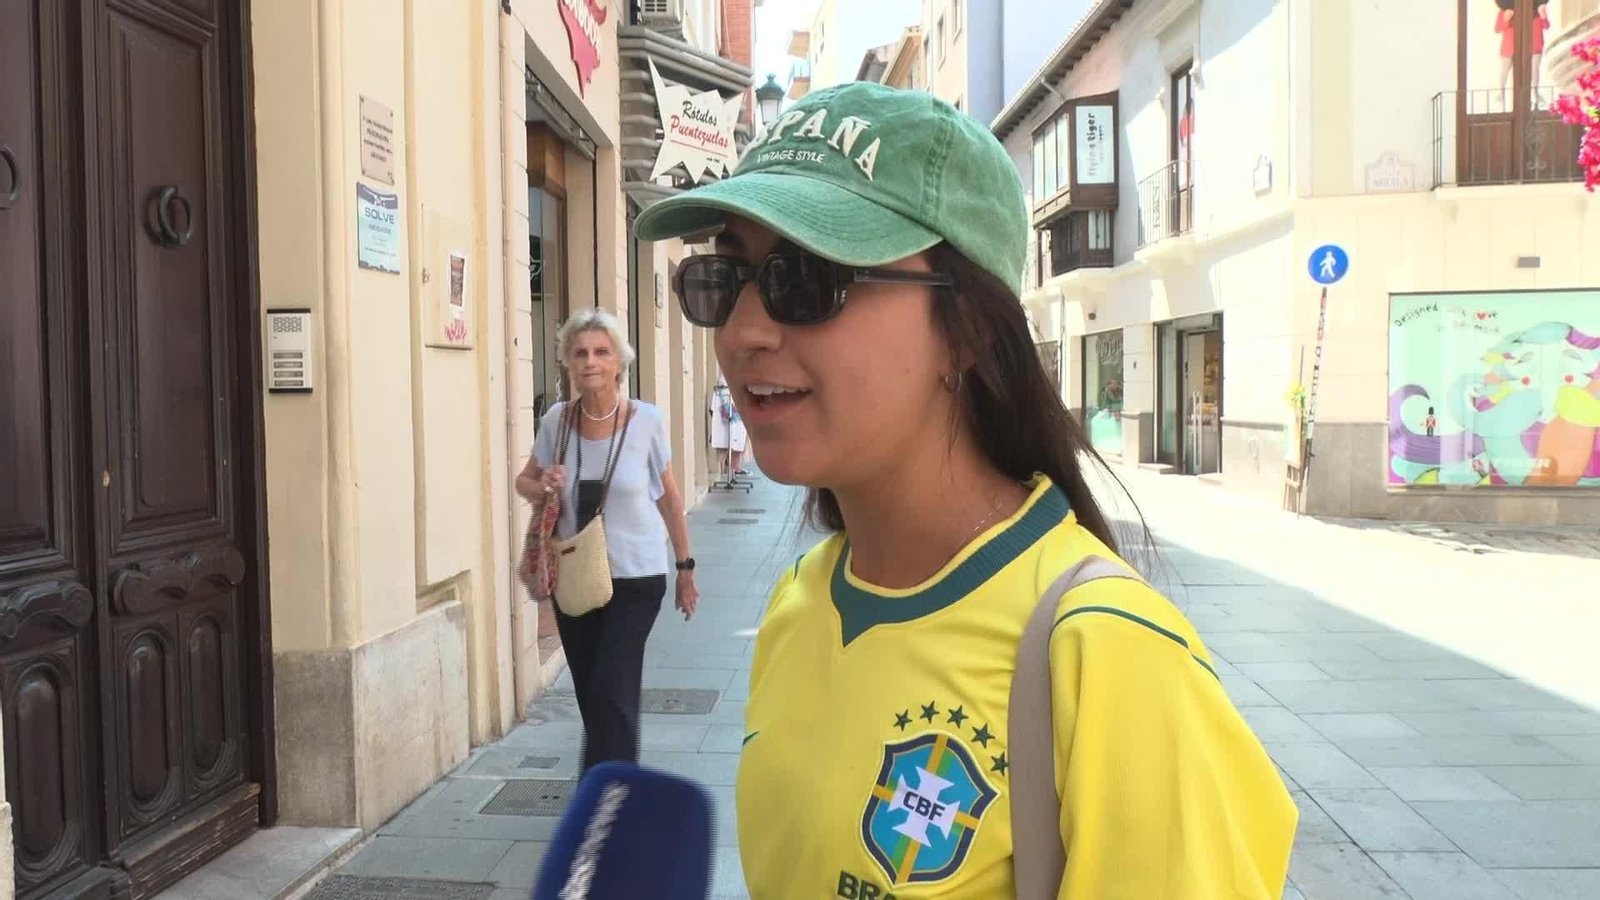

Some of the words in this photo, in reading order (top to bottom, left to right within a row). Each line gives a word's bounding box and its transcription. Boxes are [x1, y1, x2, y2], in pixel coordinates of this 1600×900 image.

[682, 100, 718, 127] Rótulos
[1087, 113, 1097, 141] tiger
[670, 115, 729, 148] Puentezuelas
[756, 150, 795, 164] VINTAGE
[795, 151, 826, 164] STYLE
[364, 206, 395, 225] SOLVE
[1394, 302, 1439, 327] Designed
[903, 791, 945, 821] CBF
[837, 870, 898, 900] BR
